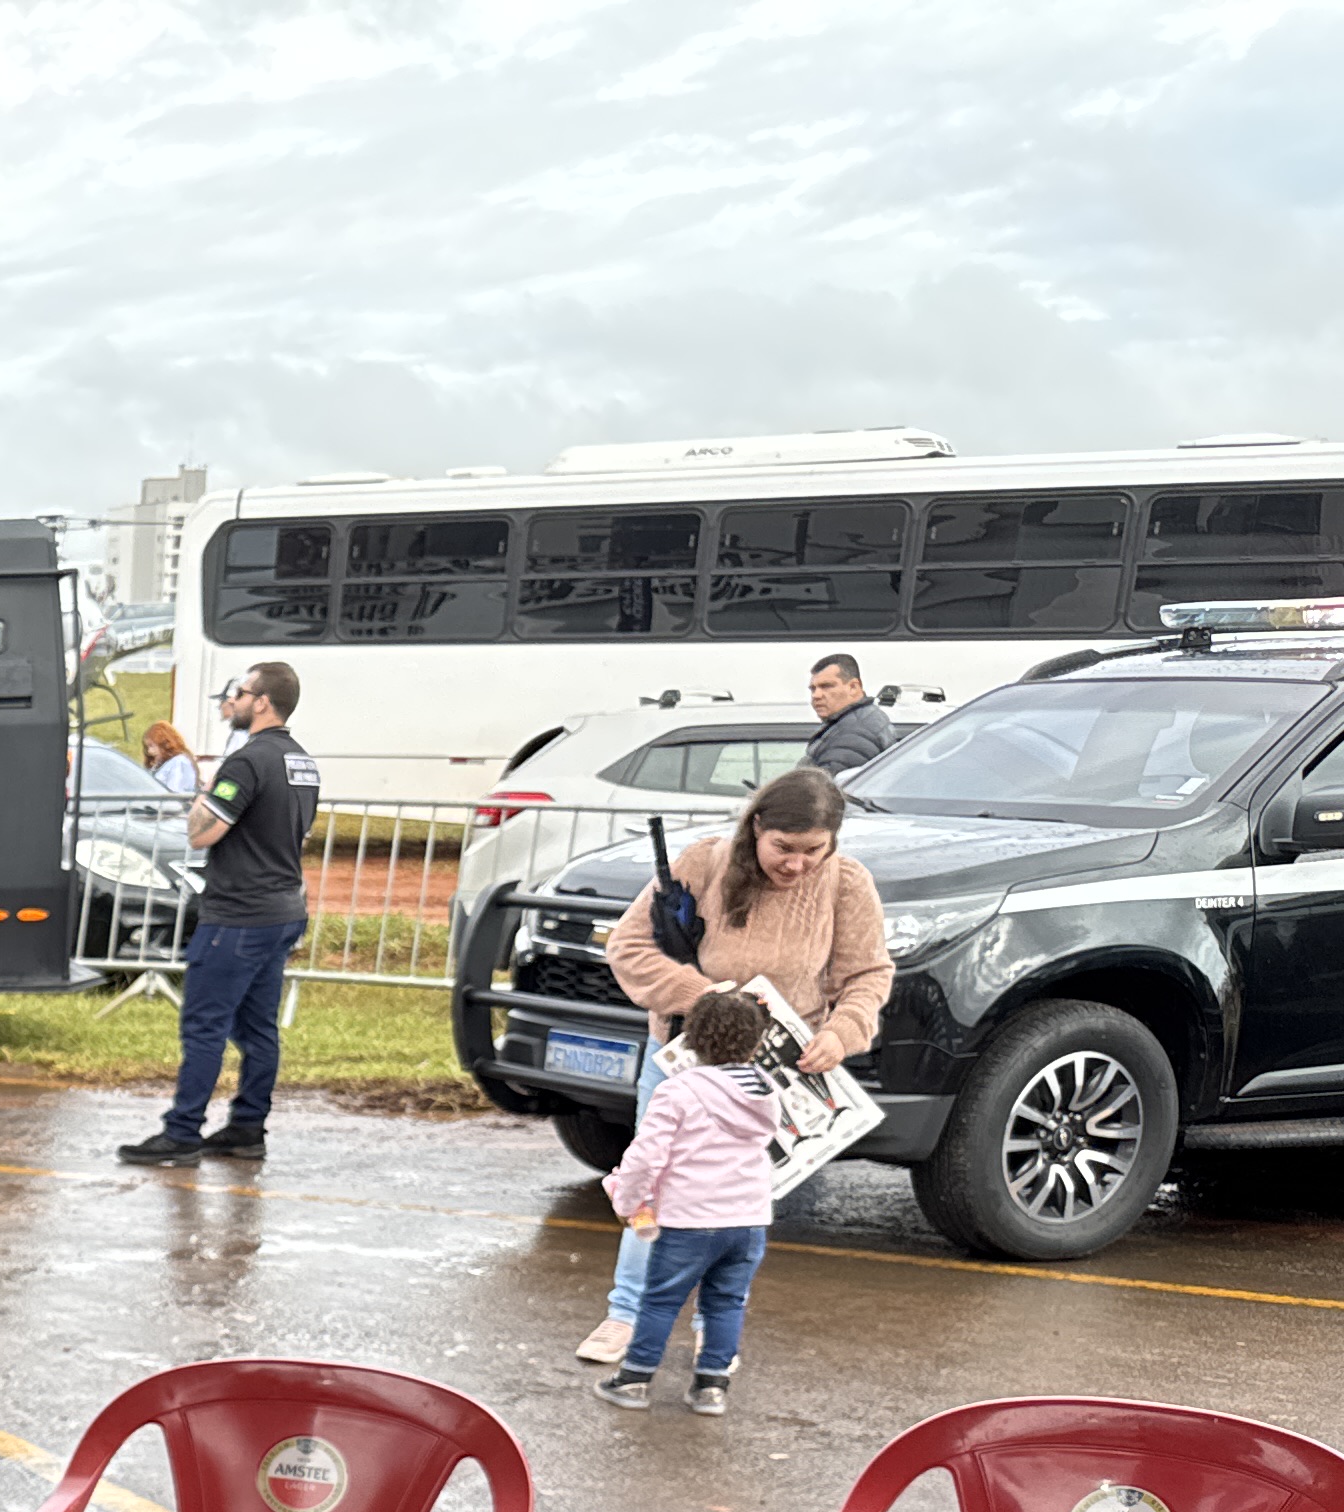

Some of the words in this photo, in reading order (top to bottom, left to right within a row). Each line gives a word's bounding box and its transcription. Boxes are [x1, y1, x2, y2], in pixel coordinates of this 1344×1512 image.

[1194, 897, 1237, 909] DEINTER
[1237, 896, 1245, 908] 4
[274, 1463, 330, 1482] AMSTEL
